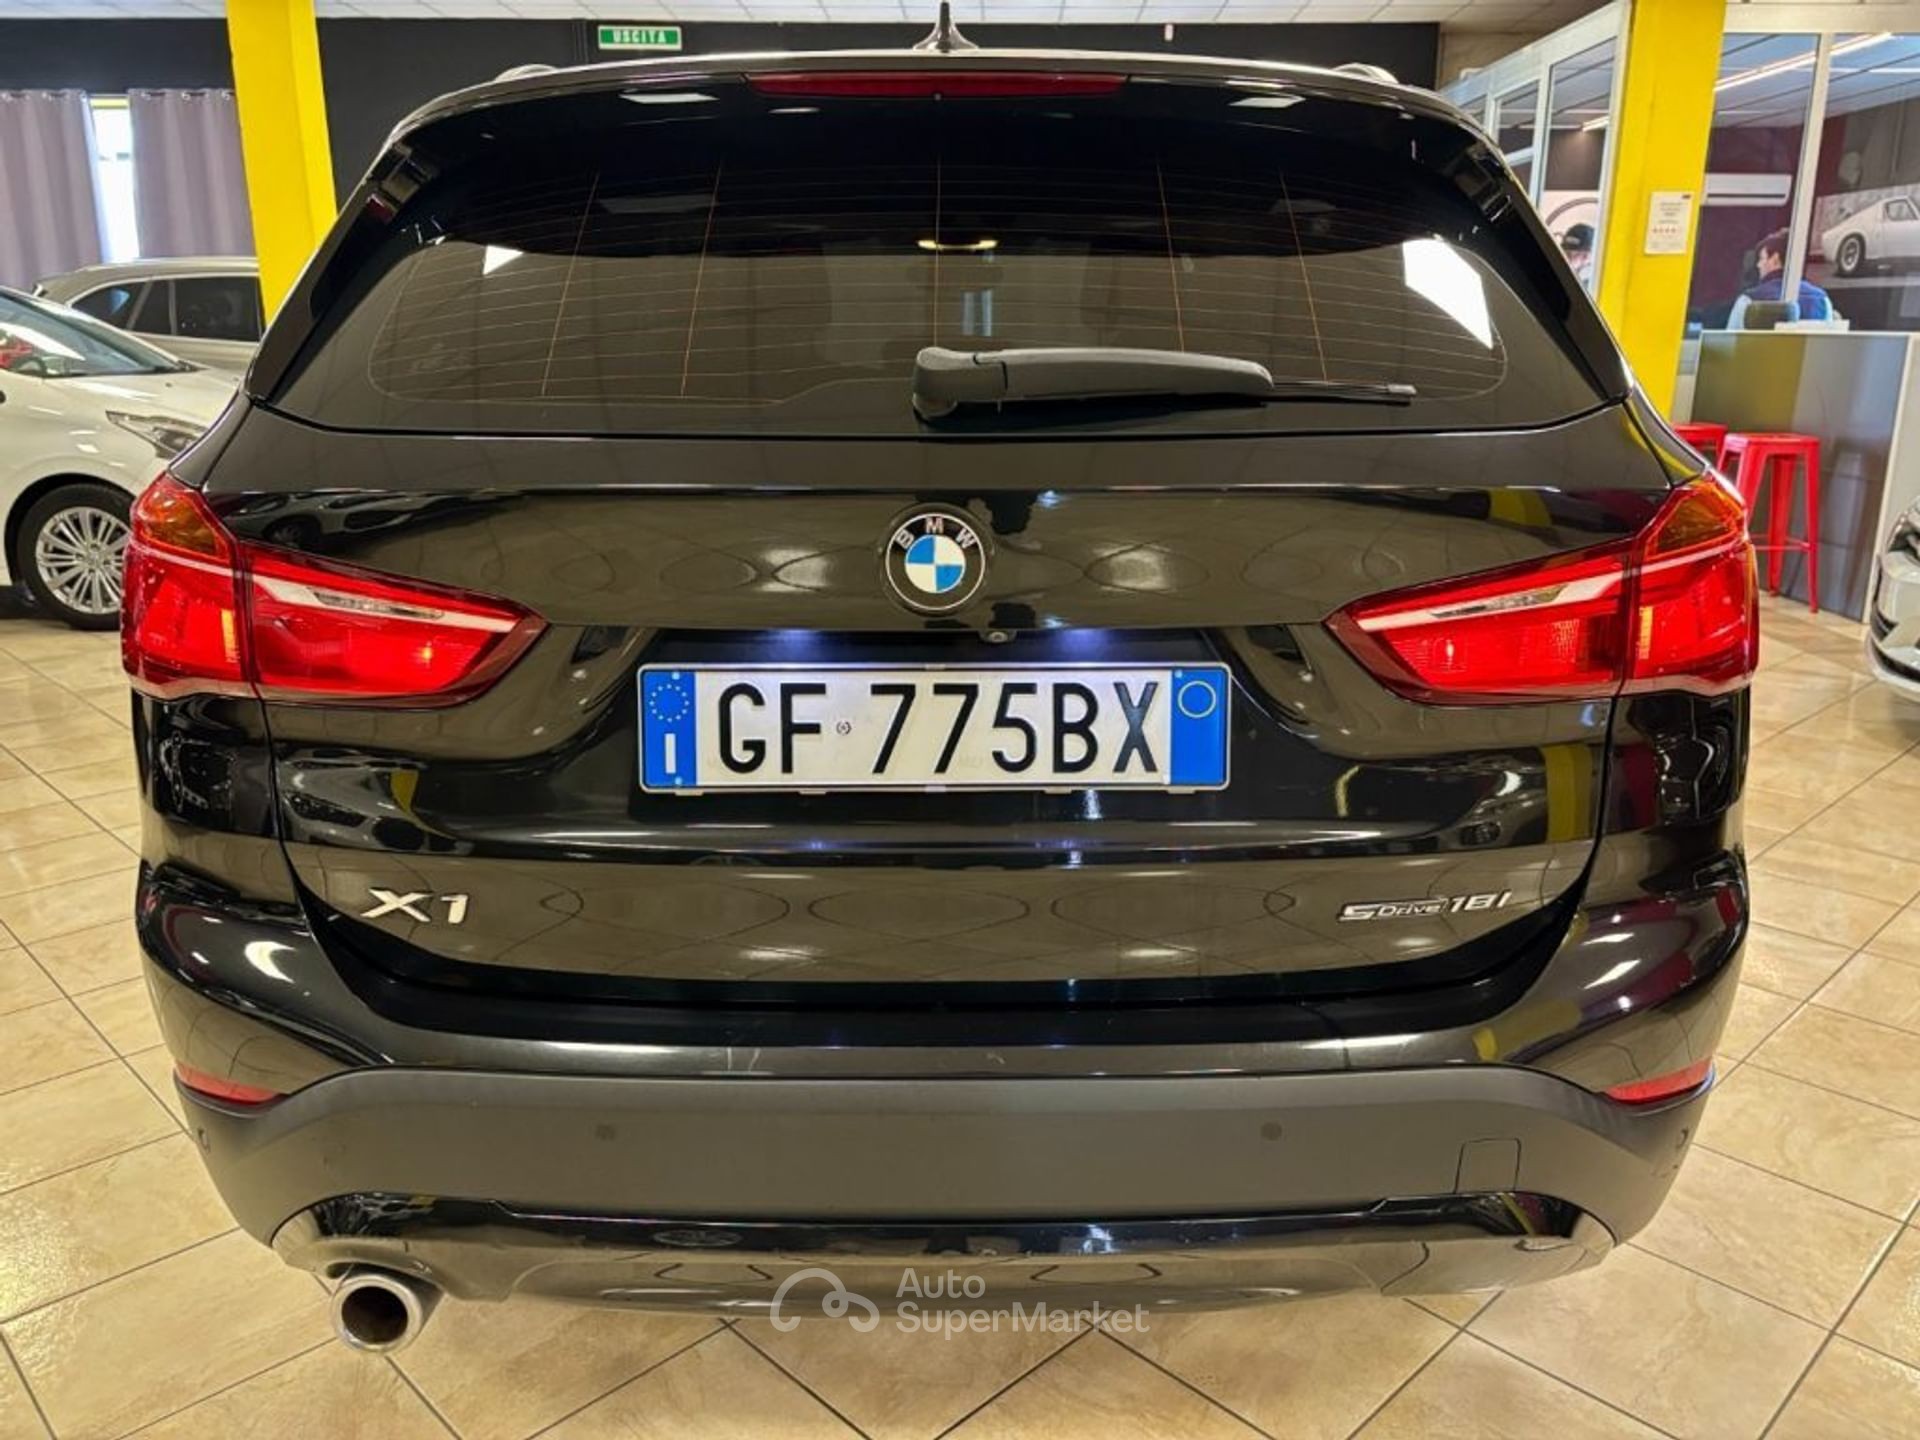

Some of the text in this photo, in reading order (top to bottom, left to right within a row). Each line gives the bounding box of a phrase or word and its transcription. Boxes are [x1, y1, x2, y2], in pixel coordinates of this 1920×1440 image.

[613, 30, 667, 43] USCITA
[894, 517, 977, 549] BMW
[718, 682, 1159, 774] GF 775BX
[360, 888, 468, 923] X1
